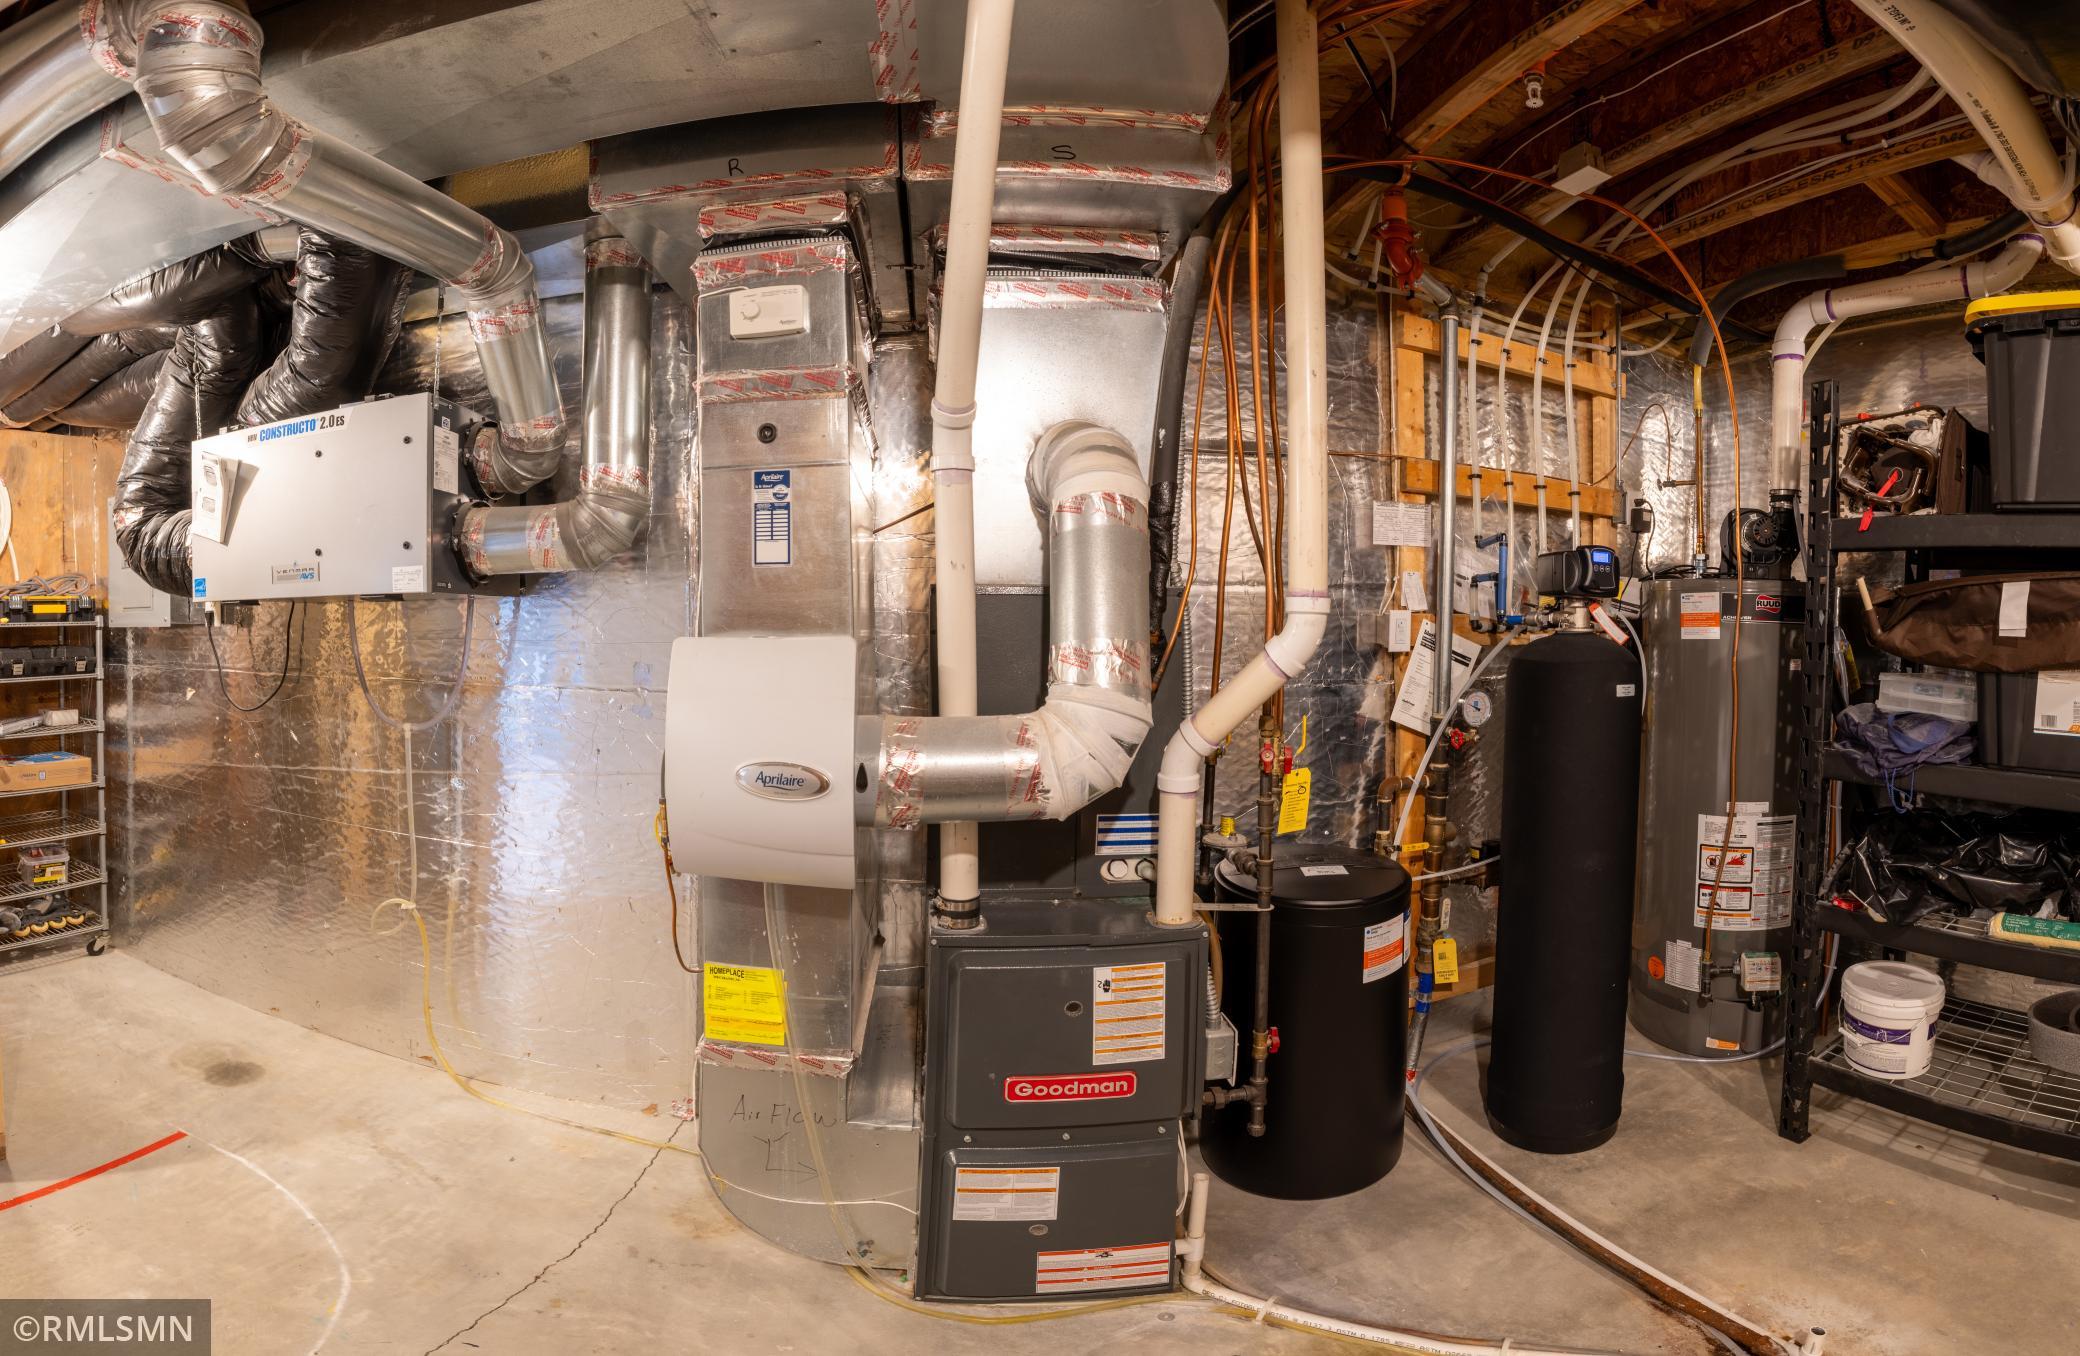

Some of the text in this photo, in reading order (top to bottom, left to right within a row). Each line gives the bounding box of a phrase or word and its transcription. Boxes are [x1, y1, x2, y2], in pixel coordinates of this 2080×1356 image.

[1050, 144, 1077, 161] S
[728, 158, 744, 177] R
[259, 417, 316, 442] CONSTRUCTO
[320, 414, 335, 430] 2.0
[336, 415, 345, 427] ES
[301, 572, 315, 580] AVS
[1756, 600, 1781, 608] RUUD
[755, 770, 805, 789] Aprilaire
[709, 966, 745, 979] HOMEPLACE
[1014, 1080, 1128, 1097] Goodman
